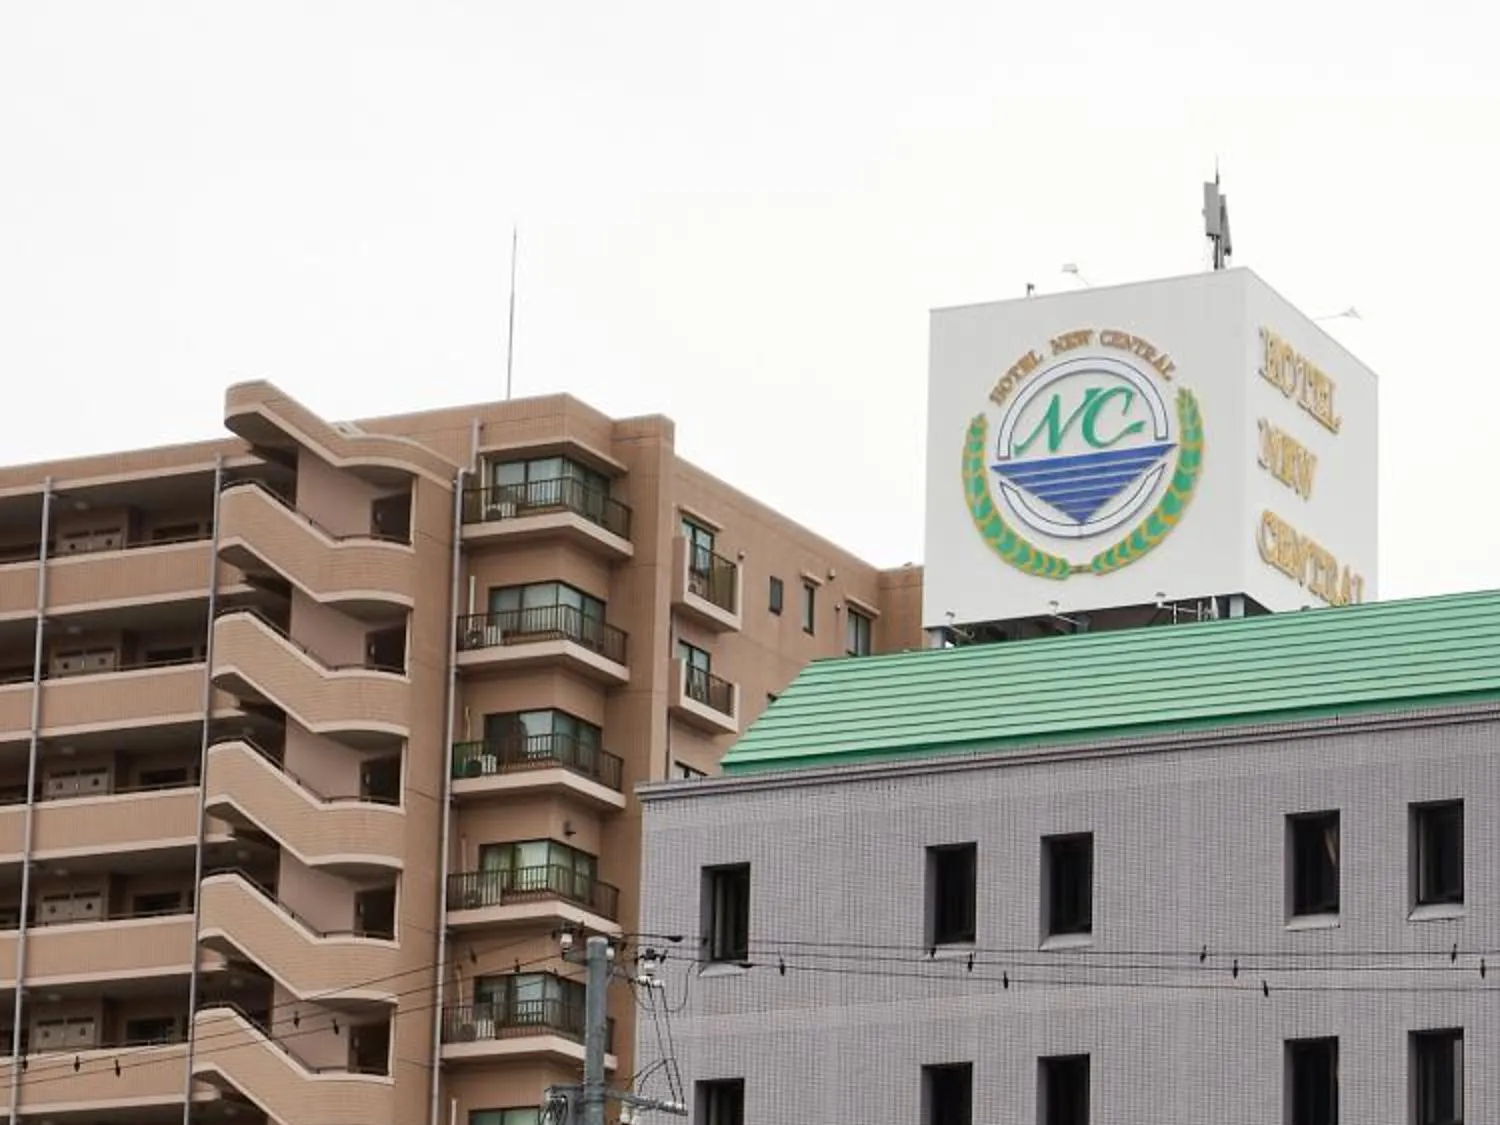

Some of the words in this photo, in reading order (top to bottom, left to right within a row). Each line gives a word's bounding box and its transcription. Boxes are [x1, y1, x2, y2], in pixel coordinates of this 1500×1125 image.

[989, 350, 1043, 406] HOTEL
[1050, 329, 1094, 355] NEW
[1100, 329, 1176, 381] CENTRAL
[1258, 325, 1342, 434] HOTEL
[1014, 385, 1147, 456] NC
[1257, 416, 1318, 502] NEW
